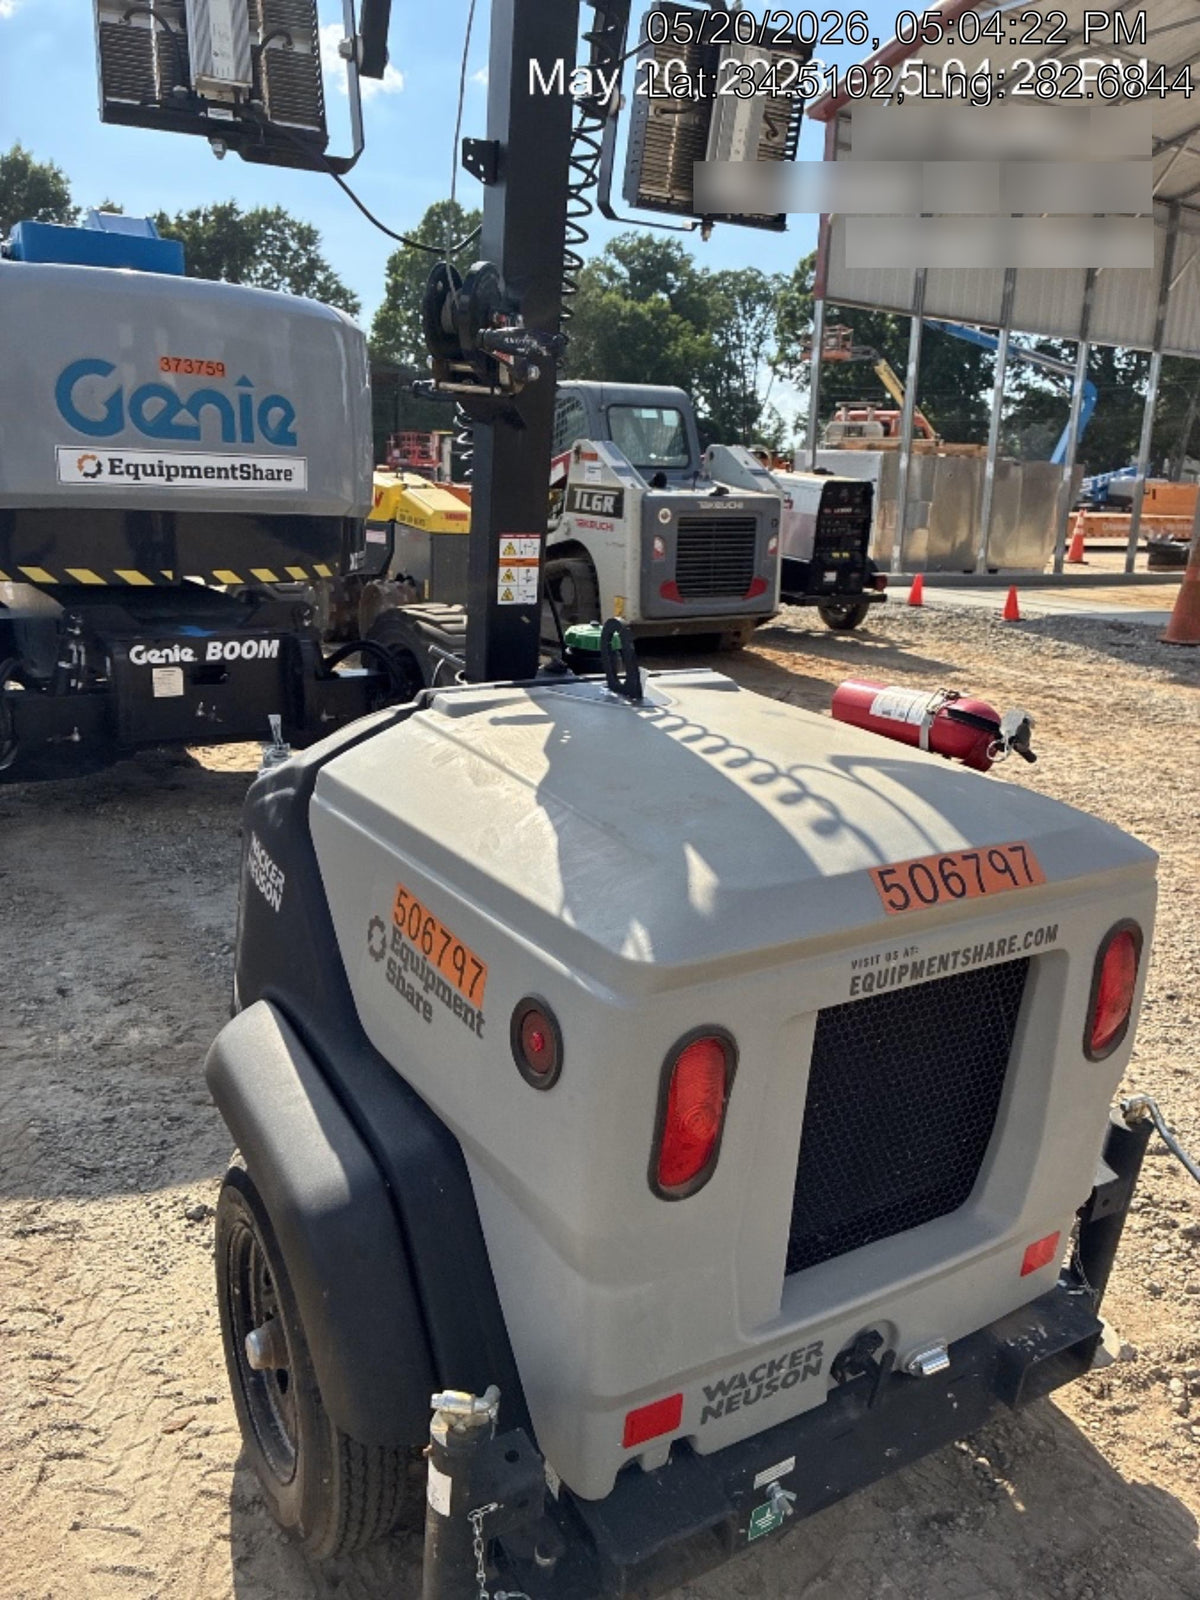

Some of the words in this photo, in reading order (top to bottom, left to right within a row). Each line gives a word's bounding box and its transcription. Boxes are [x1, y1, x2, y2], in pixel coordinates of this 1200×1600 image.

[160, 357, 225, 376] 373759
[55, 358, 298, 447] Genie
[108, 458, 293, 482] EquipmentShare
[573, 487, 620, 513] TL6R
[129, 644, 195, 665] Genie
[206, 640, 280, 661] BOOM
[876, 845, 1034, 911] 506797
[394, 889, 484, 998] 506797
[849, 923, 1059, 997] EQUIPMENTSHARE.COM
[851, 954, 881, 970] VISIT
[885, 950, 899, 963] US
[385, 956, 433, 1025] Share
[390, 926, 486, 1040] Equipment
[700, 1358, 823, 1426] NEUSON
[702, 1339, 824, 1402] WACKER
